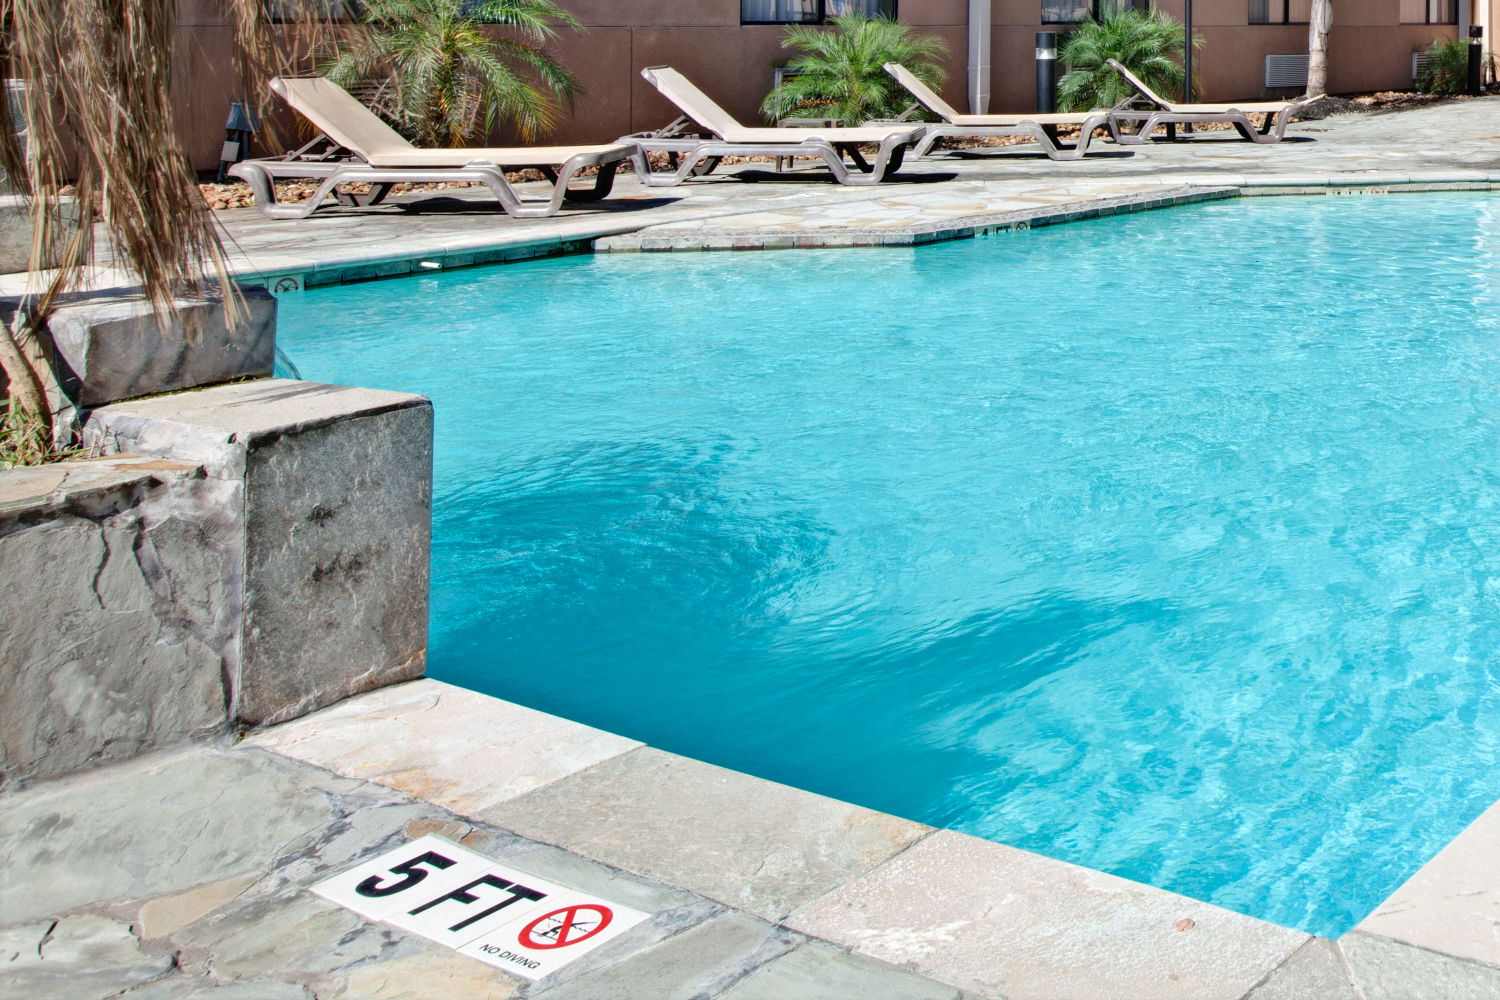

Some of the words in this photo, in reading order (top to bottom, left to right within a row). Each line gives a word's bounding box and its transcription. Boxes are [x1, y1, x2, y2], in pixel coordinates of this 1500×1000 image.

[355, 850, 458, 898] 5
[407, 874, 548, 932] FT
[479, 943, 501, 955] NO
[498, 950, 541, 970] DIVING
